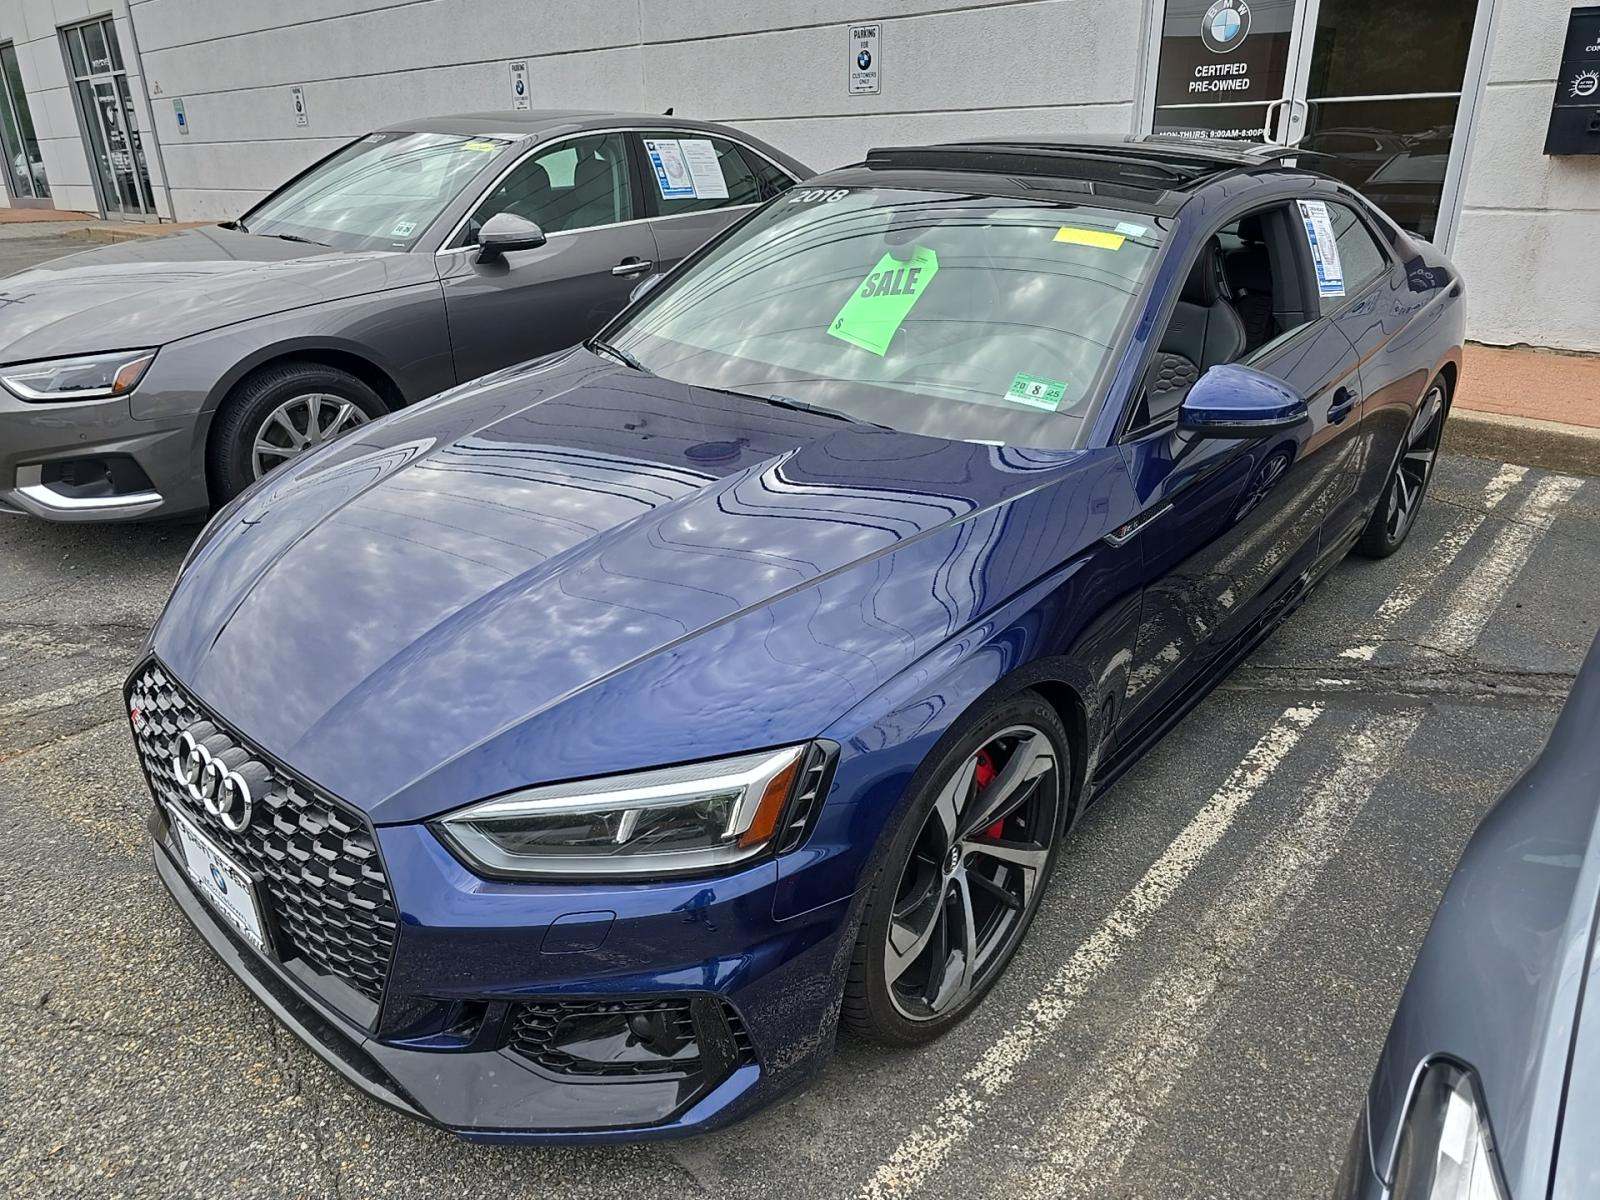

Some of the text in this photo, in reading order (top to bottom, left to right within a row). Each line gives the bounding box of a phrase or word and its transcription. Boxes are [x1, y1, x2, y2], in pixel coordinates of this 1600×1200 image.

[853, 29, 876, 39] PARKING
[1195, 63, 1248, 78] CERTIFIED
[1188, 78, 1250, 93] PRE-OWNED
[788, 189, 850, 204] 2018
[860, 267, 922, 299] SALE
[1032, 384, 1042, 395] 8
[1046, 389, 1060, 398] 25
